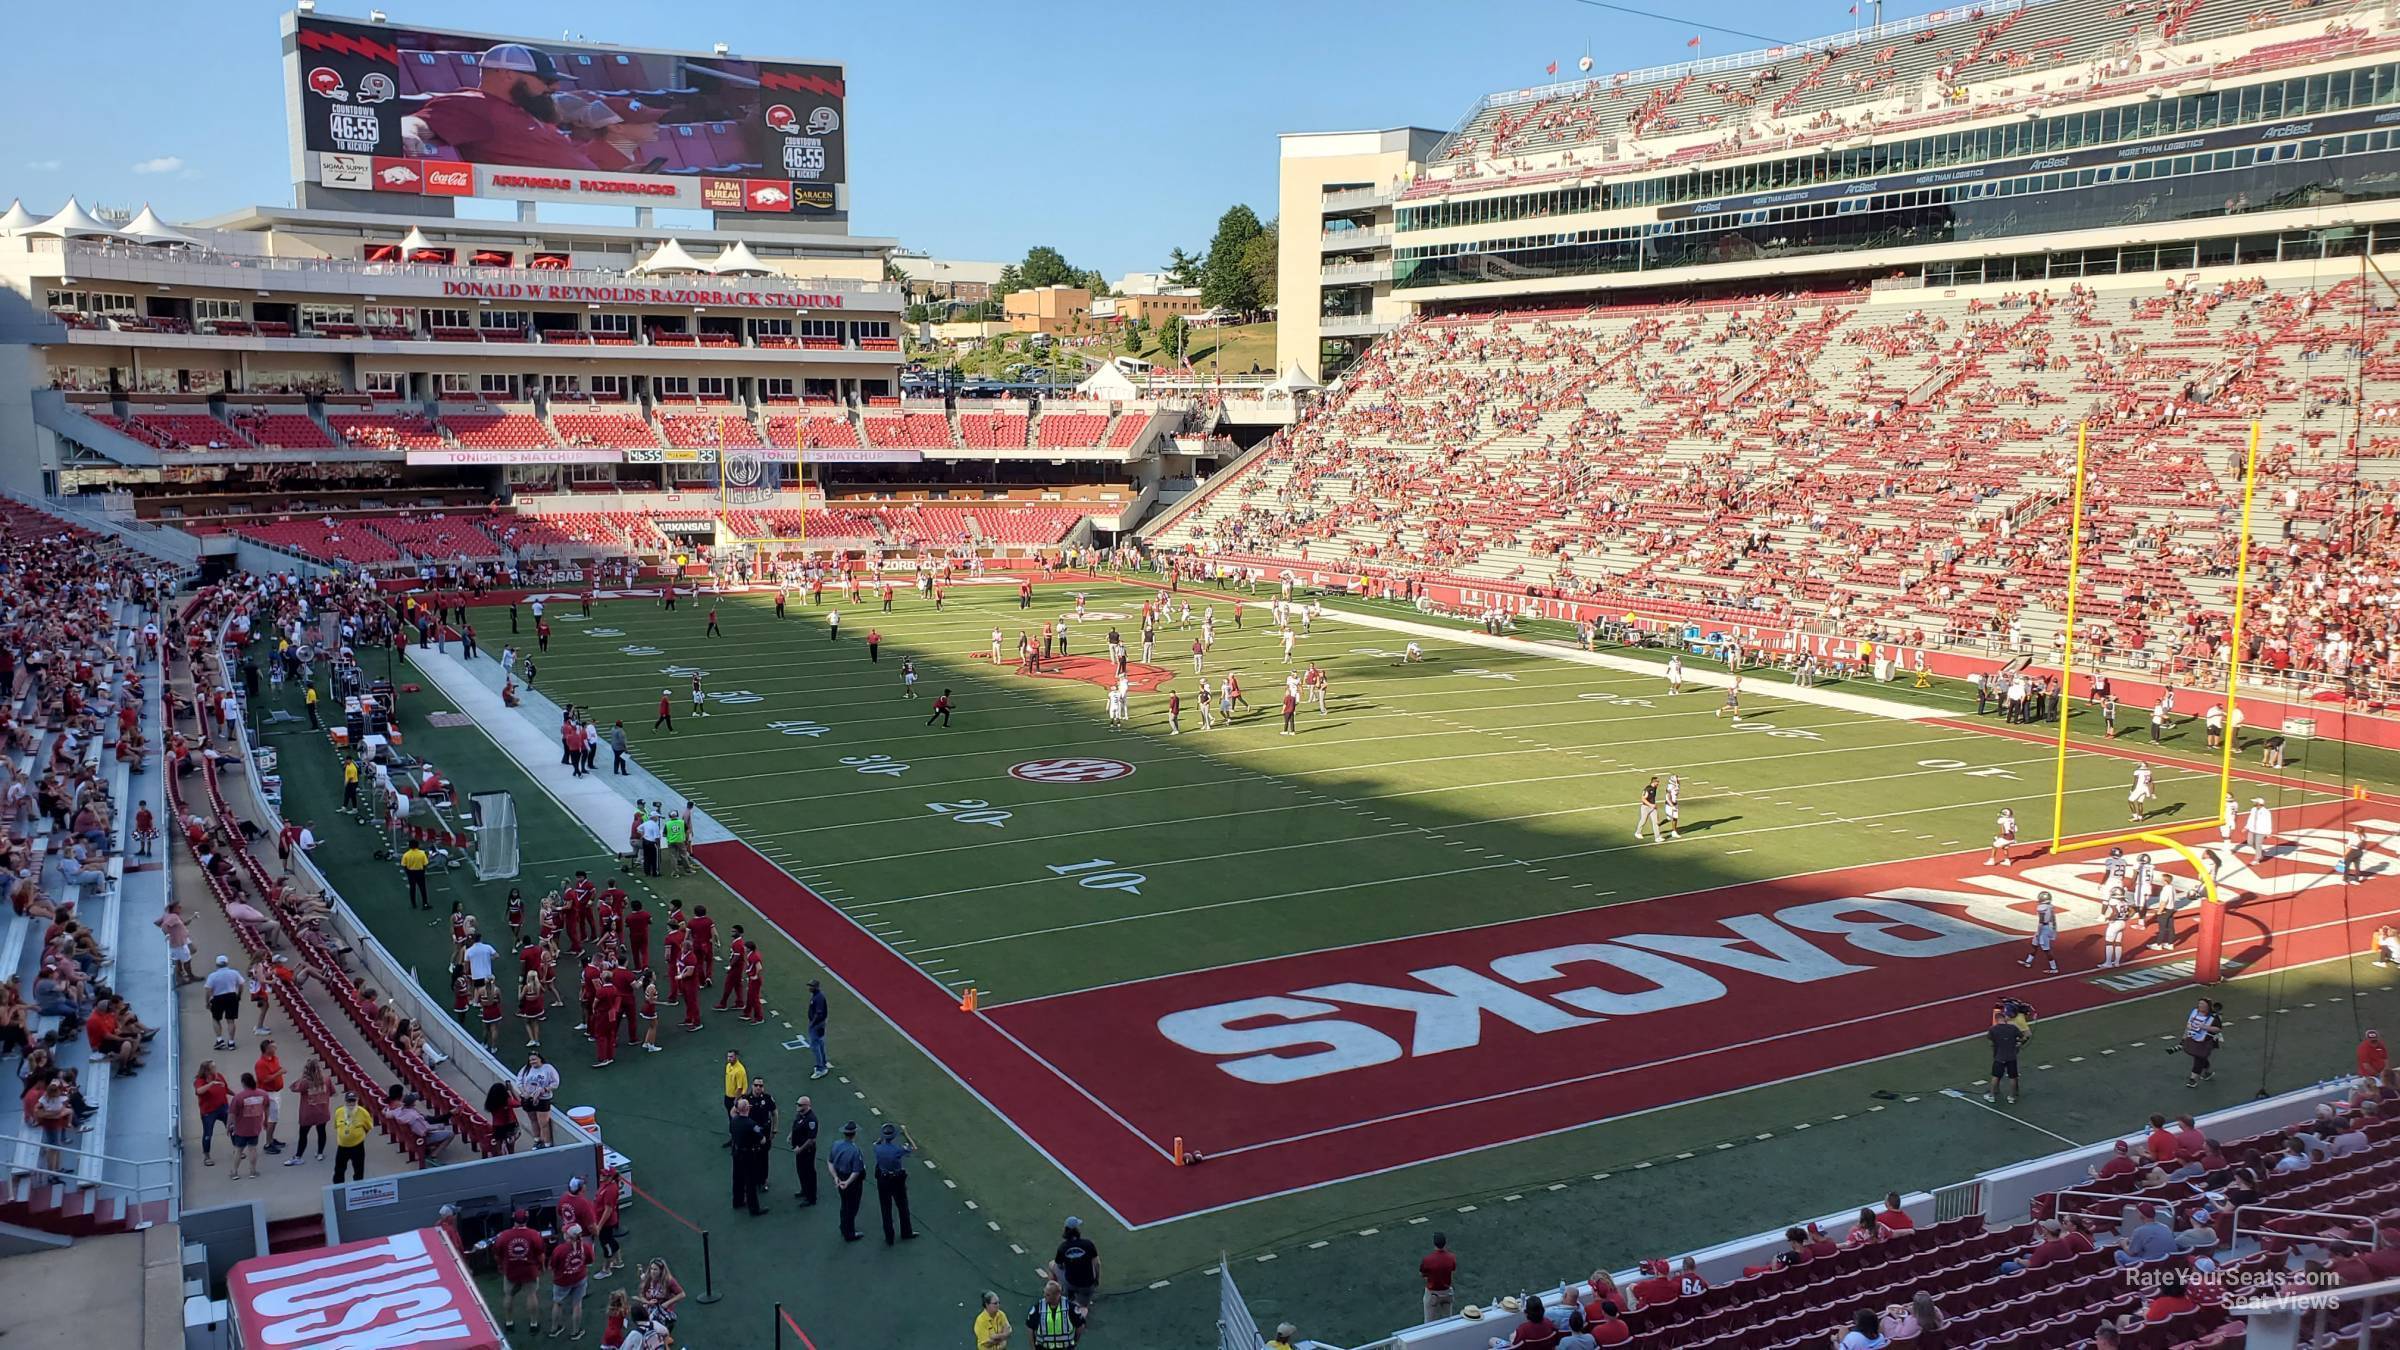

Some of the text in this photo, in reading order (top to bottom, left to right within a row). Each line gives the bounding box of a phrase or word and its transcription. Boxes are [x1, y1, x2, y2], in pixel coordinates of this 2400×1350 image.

[332, 104, 374, 116] COUNTDOWN
[333, 116, 376, 141] 46:55
[2262, 122, 2313, 139] ArcBest
[337, 141, 374, 152] TO KICKOFF
[785, 137, 821, 146] COUNTDOWN
[2118, 138, 2204, 158] MORE THAN LOGISTICS
[785, 147, 823, 168] 46:55
[2029, 156, 2070, 171] ArcBest
[346, 164, 369, 172] SUPPLY
[788, 169, 819, 179] TO KICKOFF
[1915, 168, 1985, 184] MORE THAN LOGISTICS
[492, 175, 676, 196] ARKANSAS RAZORBACKS
[714, 182, 739, 191] FARM
[1844, 181, 1878, 195] ArcBest
[705, 189, 740, 199] BUREAU
[1753, 191, 1809, 204] MORE THAN LOGISTICS
[1694, 202, 1722, 213] ArcBest
[443, 281, 844, 308] DONALD W REYNOLDS RAZORBACK STADIUM
[449, 452, 584, 463] TONIGHT'S MATCHUP
[630, 451, 662, 461] 46:55
[700, 451, 714, 461] 25
[827, 451, 884, 461] MATCHUP
[659, 522, 711, 532] ARKANSAS
[767, 720, 831, 736] 40
[839, 753, 910, 775] 30
[925, 799, 1013, 824] 20
[1046, 858, 1147, 889] 10
[245, 1229, 471, 1350] TUSK
[1681, 1277, 1702, 1295] 64
